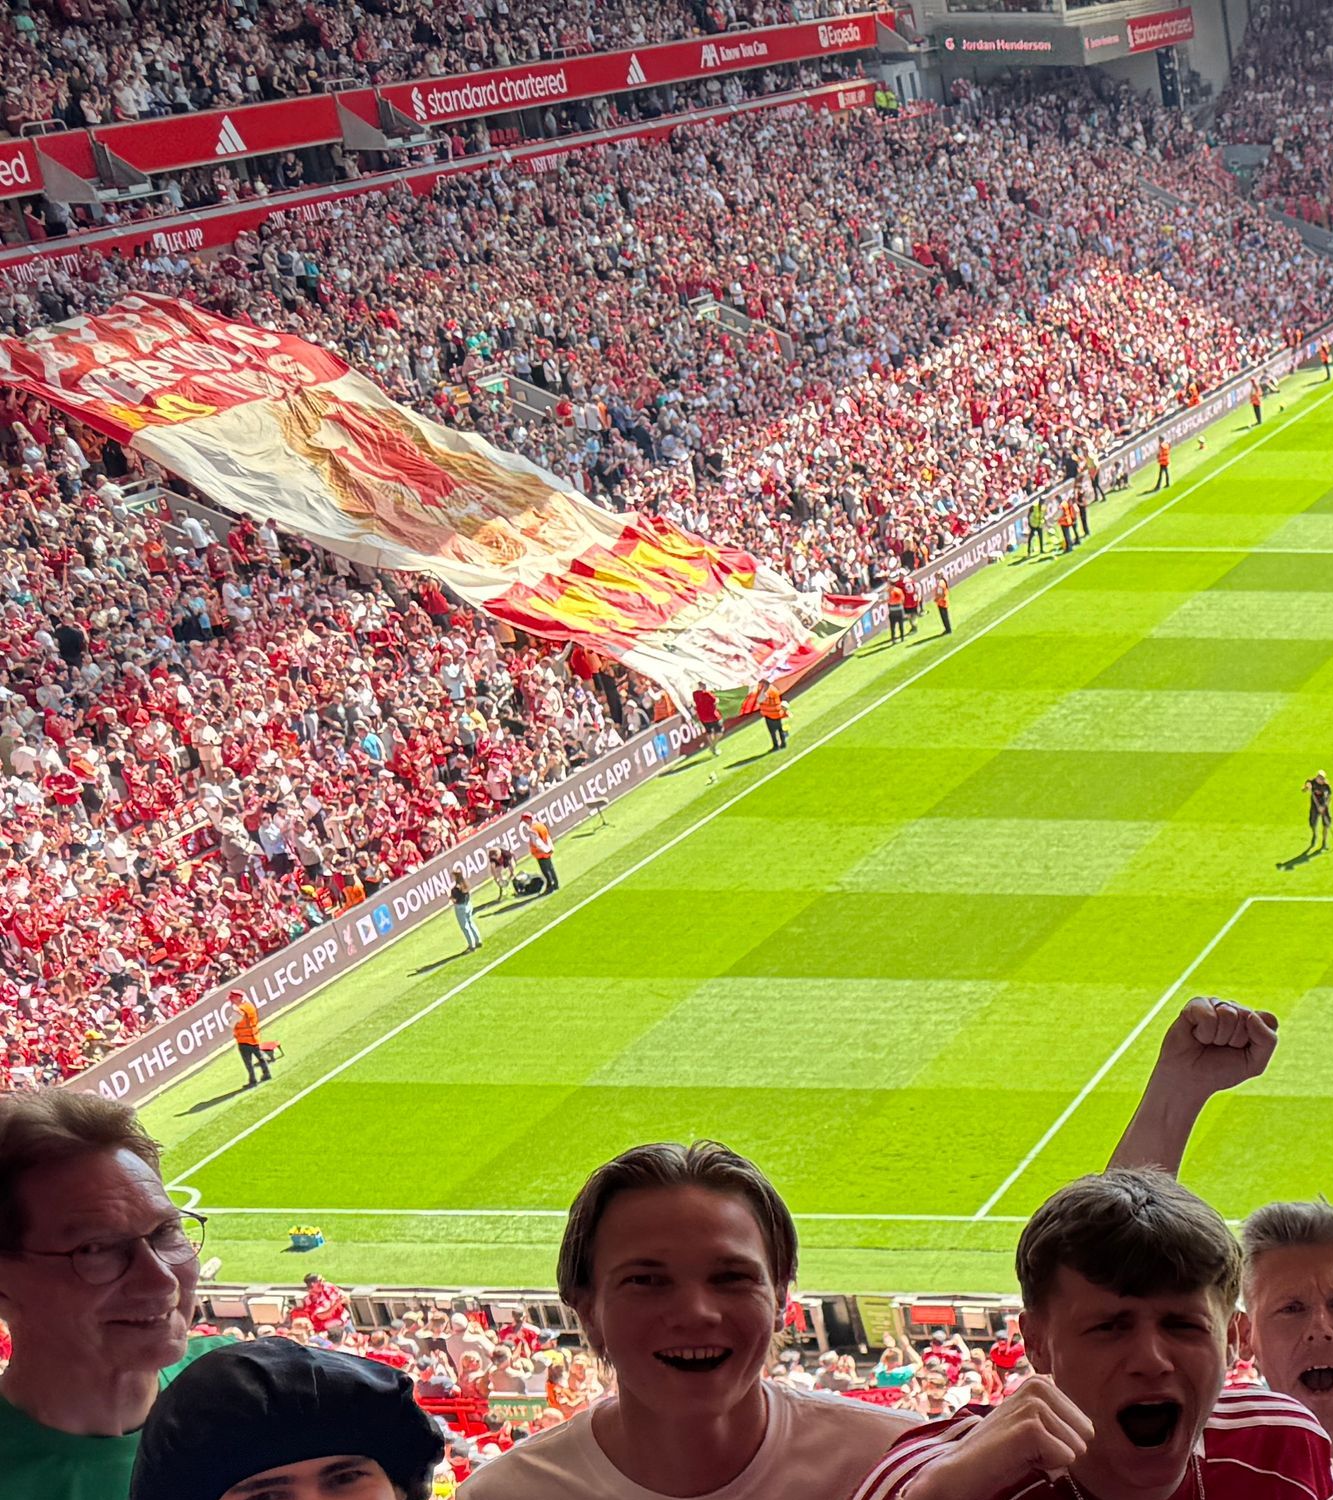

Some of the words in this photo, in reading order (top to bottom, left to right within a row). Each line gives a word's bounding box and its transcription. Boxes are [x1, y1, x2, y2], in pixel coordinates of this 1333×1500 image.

[828, 23, 861, 47] Expedia
[962, 39, 995, 51] Jordan
[996, 39, 1051, 51] Henderson
[427, 79, 500, 115] standard
[499, 68, 568, 103] chartered
[580, 772, 609, 803] LFC
[606, 758, 632, 791] APP
[128, 1038, 177, 1083] THE
[176, 991, 266, 1055] OFFICL
[264, 961, 304, 1003] LFC
[302, 938, 339, 981] APP
